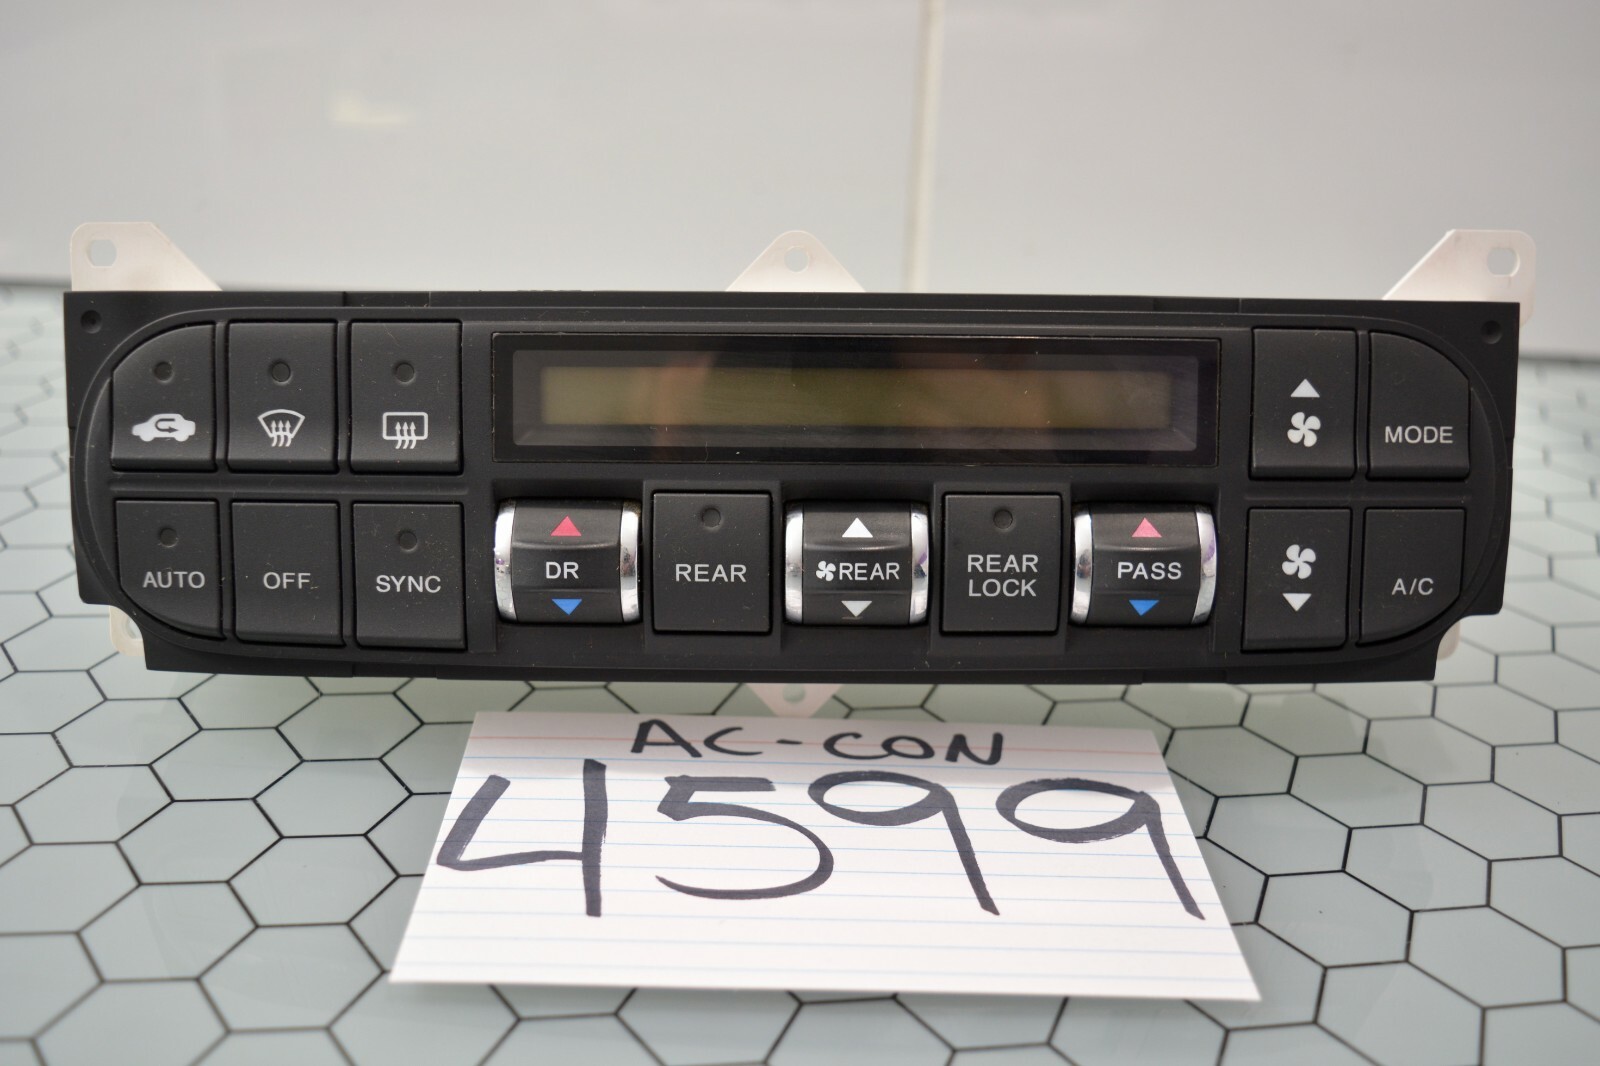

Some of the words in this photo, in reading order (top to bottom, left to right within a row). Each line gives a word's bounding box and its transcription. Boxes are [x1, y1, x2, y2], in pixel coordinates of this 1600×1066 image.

[1384, 425, 1453, 444] MODE
[545, 561, 580, 580] DR
[674, 563, 747, 583] REAR
[838, 562, 900, 581] REAR
[967, 554, 1039, 573] REAR
[1117, 561, 1182, 580] PASS
[142, 570, 206, 589] AUTO
[262, 571, 311, 590] OFF
[375, 574, 442, 594] SYNC
[967, 577, 1037, 597] LOCK
[1391, 577, 1434, 596] A/C
[631, 714, 1003, 766] AC-CON
[437, 758, 1204, 919] 4599
